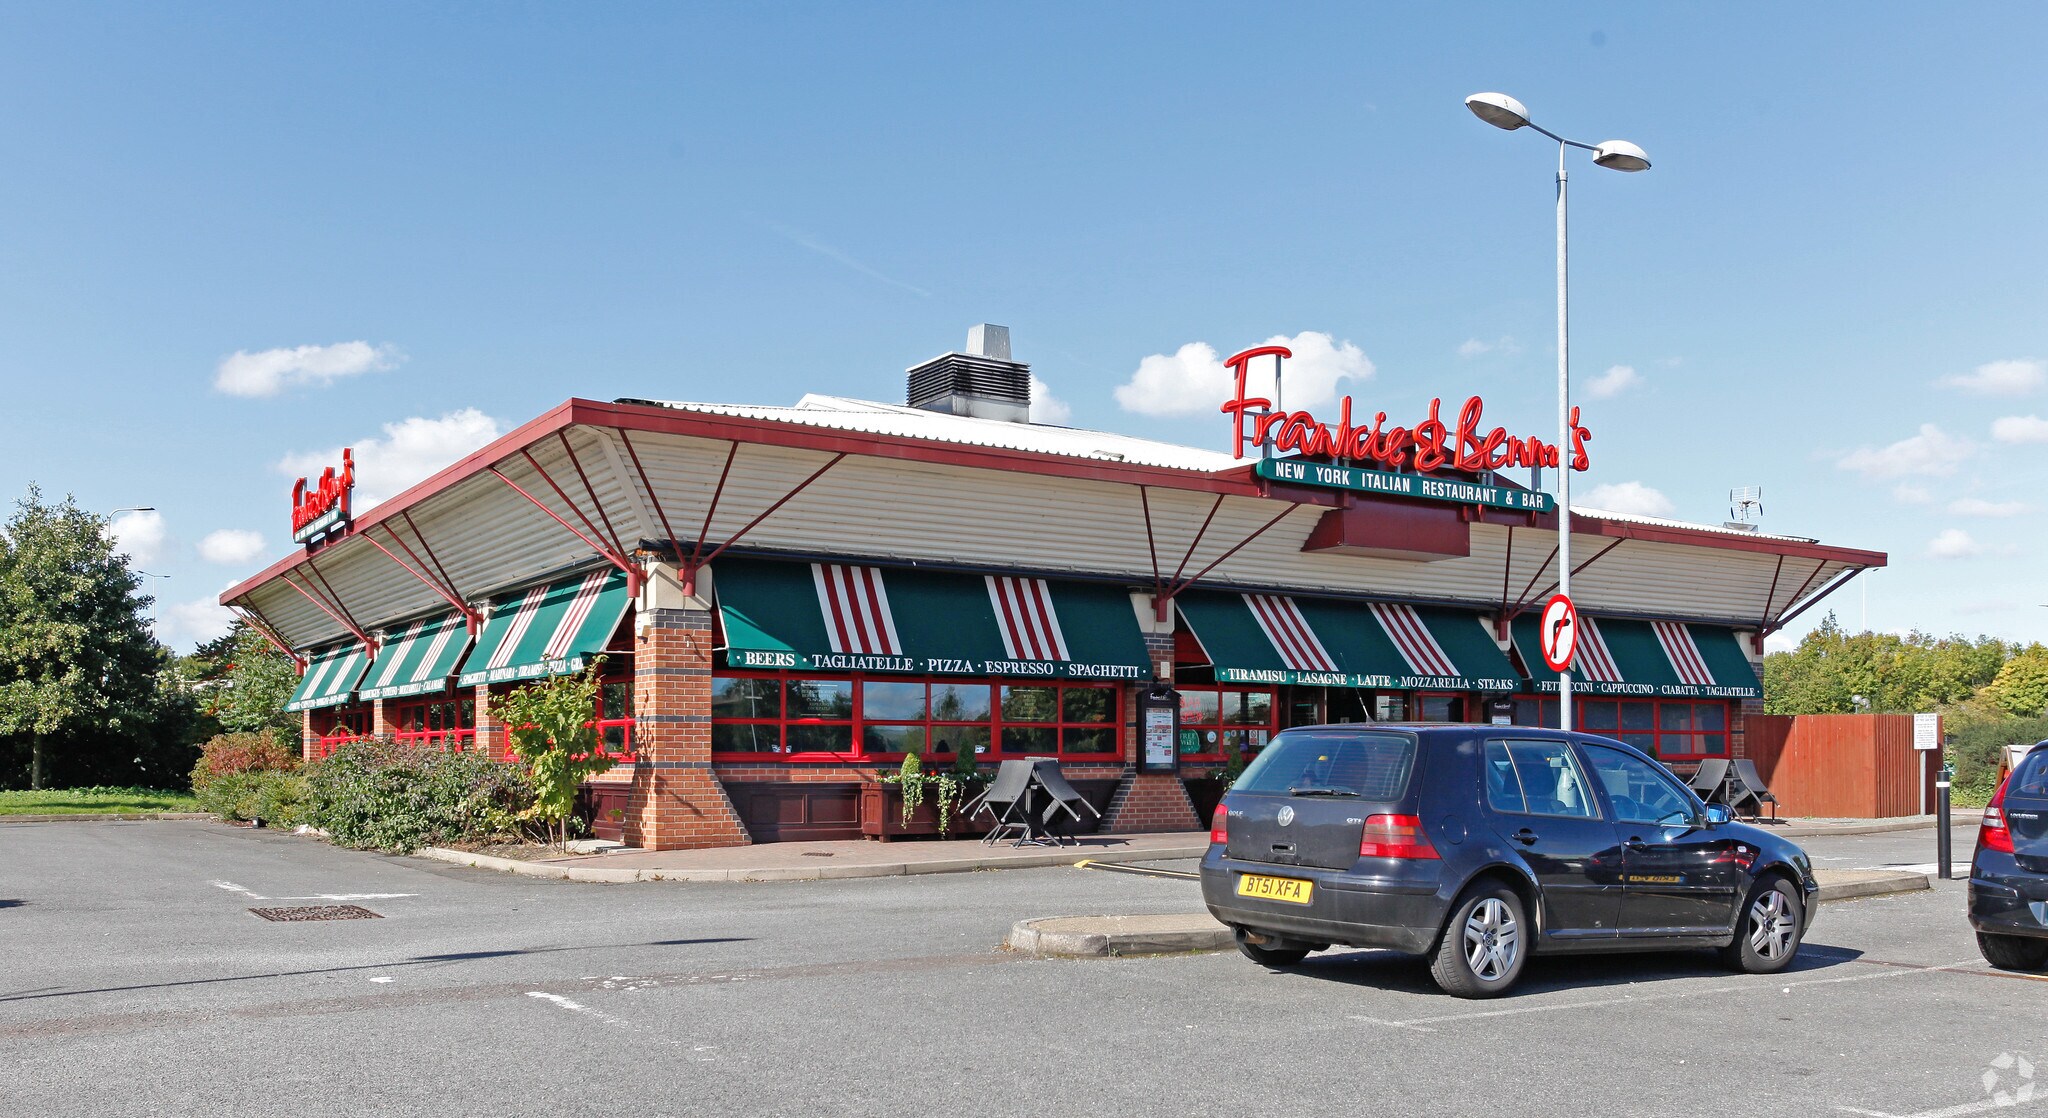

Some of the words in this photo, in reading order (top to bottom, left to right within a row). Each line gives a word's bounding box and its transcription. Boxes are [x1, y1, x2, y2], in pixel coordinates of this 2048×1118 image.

[1220, 346, 1406, 466] Frankie
[1412, 397, 1447, 472] &
[1275, 461, 1305, 480] NEW
[1316, 466, 1350, 486] YORK
[1361, 473, 1411, 493] ITALIAN
[1422, 480, 1498, 503] RESTAURANT
[1505, 491, 1513, 505] &
[1522, 492, 1544, 509] BAR
[745, 651, 795, 667] BEERS
[812, 654, 914, 671] TAGLIATELLE
[928, 658, 974, 673] PIZZA
[985, 660, 1054, 676] ESPRESSO
[1068, 663, 1139, 678] SPAGHETTI
[1228, 668, 1287, 682] TIRAMISU
[1296, 672, 1348, 686] LASAGNE
[1357, 674, 1391, 687] LATTE
[1400, 675, 1470, 689] MOZZARELLA
[1477, 678, 1514, 690] STEAKS
[1541, 680, 1594, 692] FETTCCINI
[1601, 683, 1654, 694] CAPPUCCINO
[1662, 684, 1700, 696] CIABATTA
[1706, 686, 1756, 697] TAGLIATELLE
[1246, 877, 1273, 895] BT51
[1276, 880, 1301, 899] XFA
